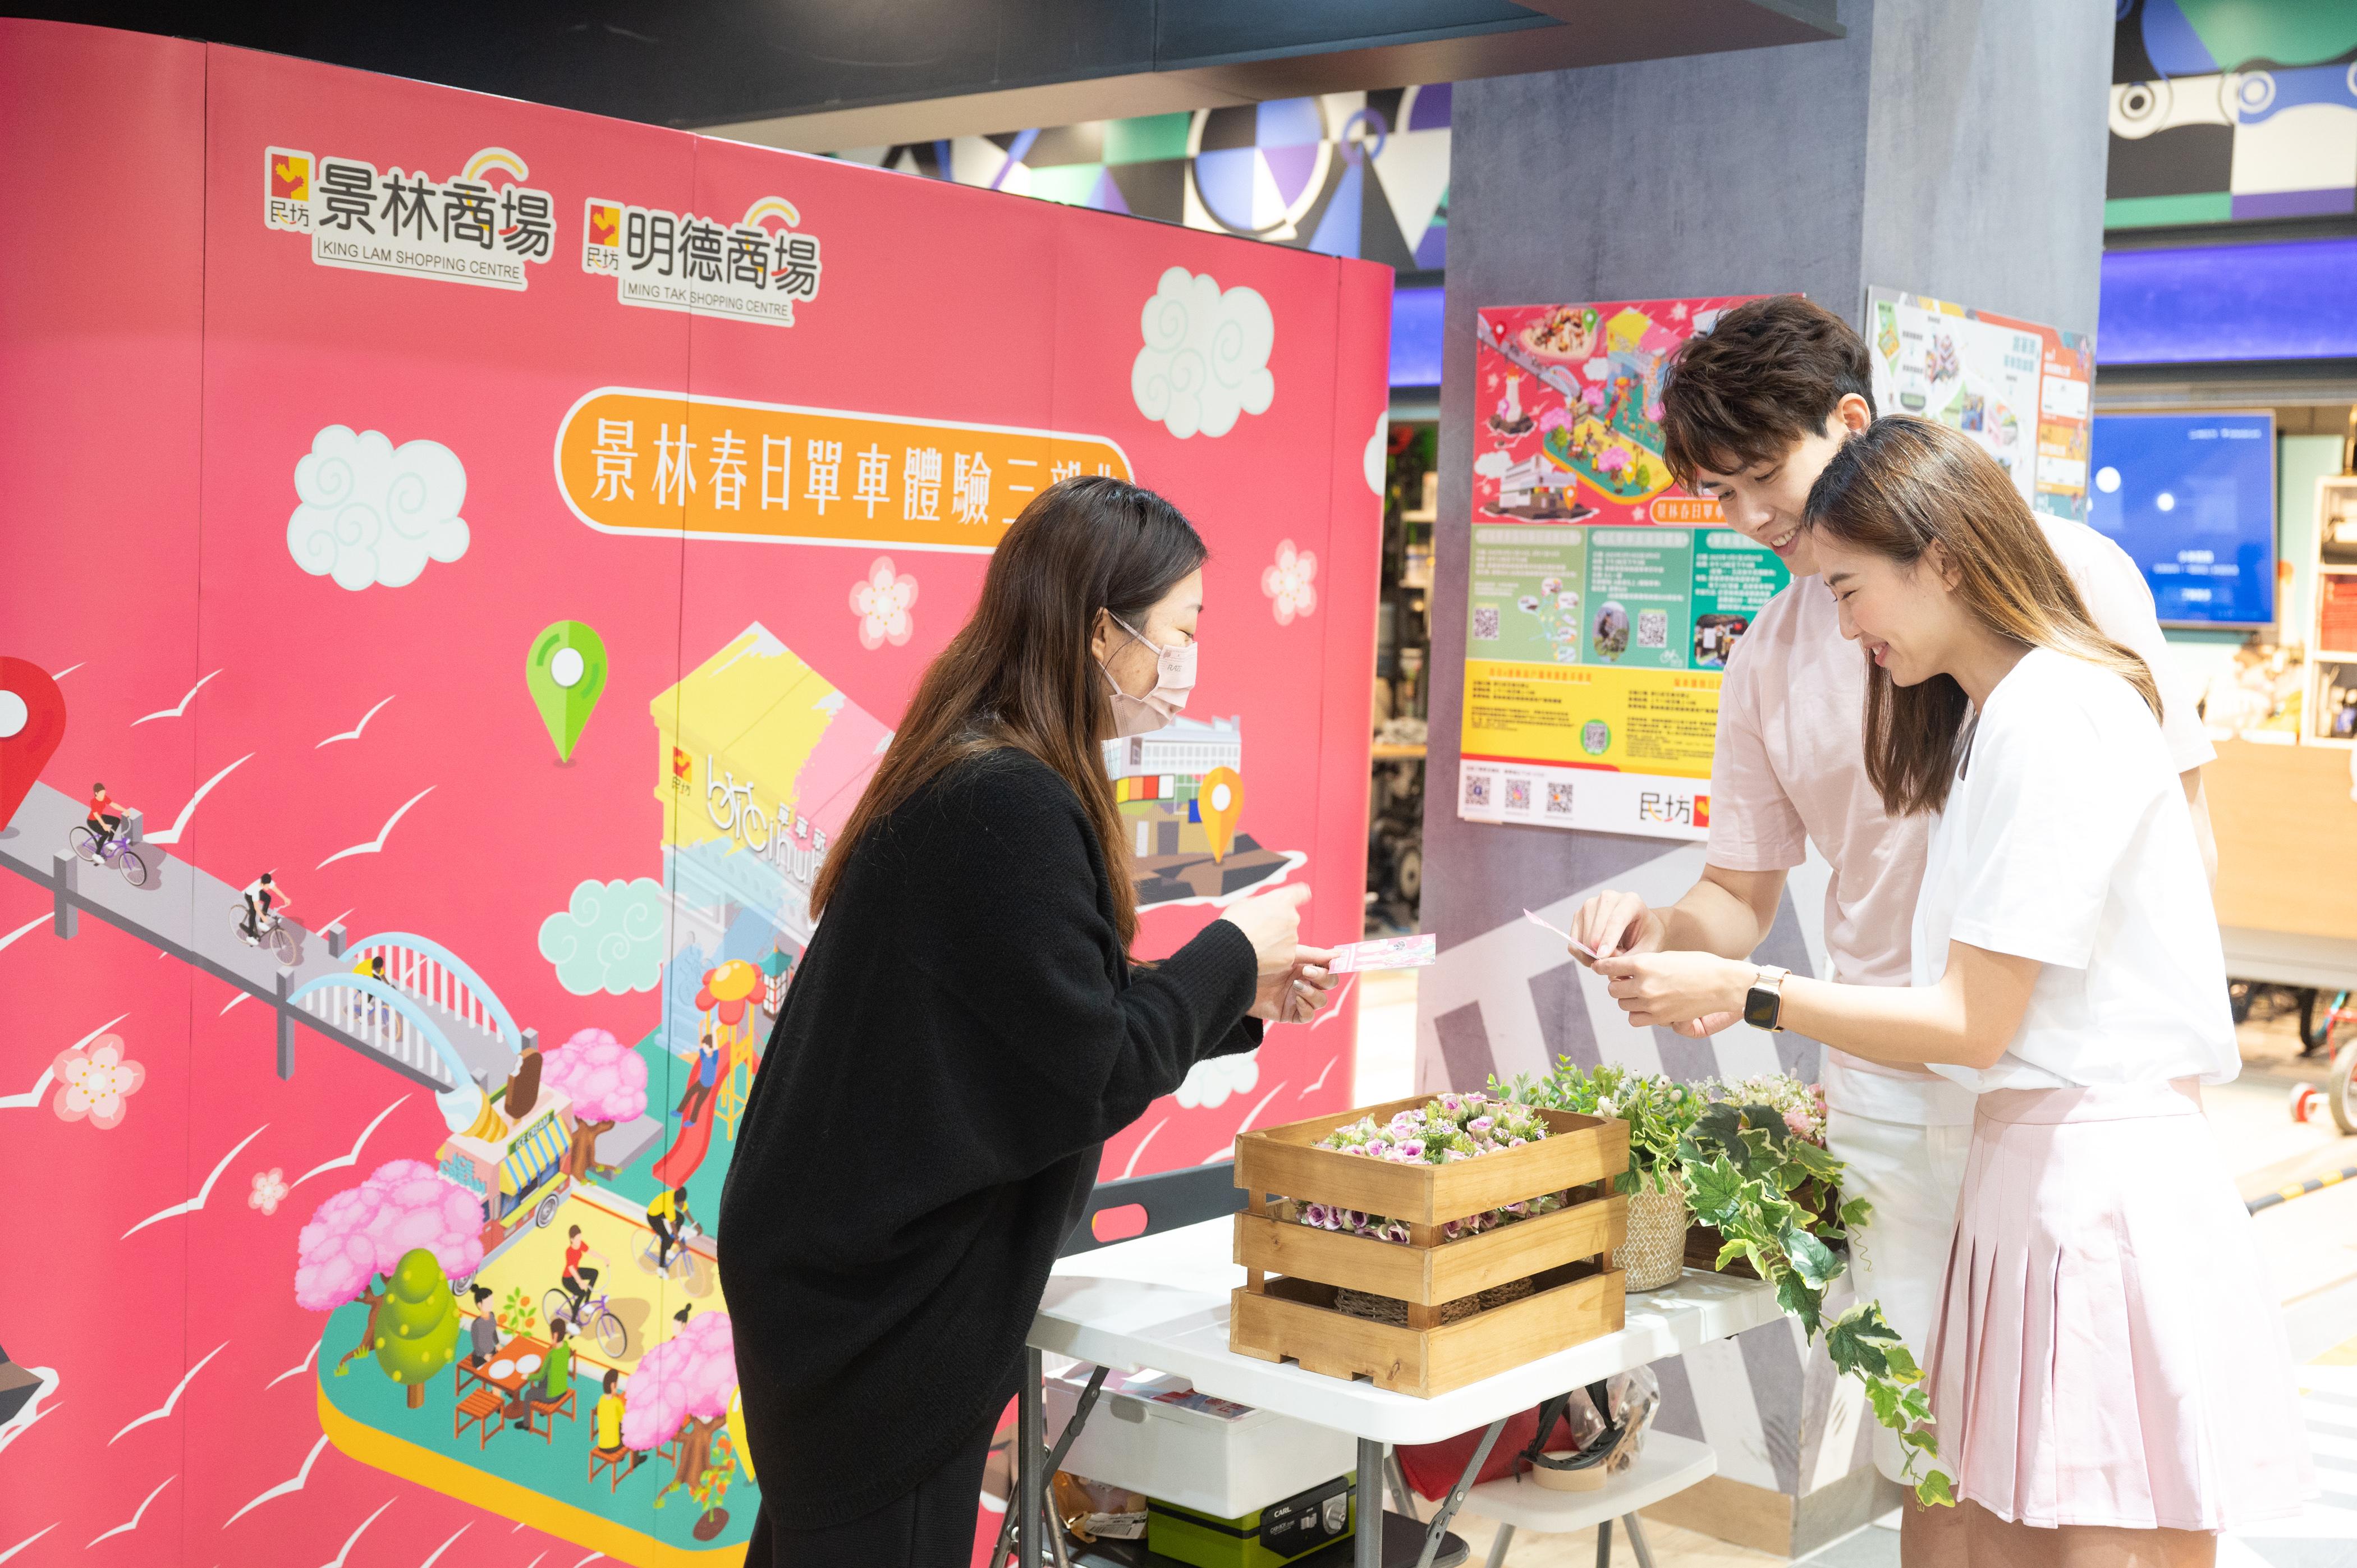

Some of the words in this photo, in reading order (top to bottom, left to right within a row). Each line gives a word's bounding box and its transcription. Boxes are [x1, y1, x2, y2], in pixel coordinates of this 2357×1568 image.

[270, 200, 309, 227] 民坊
[319, 163, 551, 256] 景林商場
[324, 240, 358, 256] KING
[363, 246, 391, 262] LAM
[396, 250, 466, 272] SHOPPING
[470, 260, 520, 279] CENTRE
[587, 246, 618, 270] 民坊
[627, 212, 817, 295] 明德商場
[628, 282, 661, 297] MING
[664, 287, 686, 301] TAK
[690, 291, 744, 310] SHOPPING
[746, 300, 788, 317] CENTRE
[591, 418, 1117, 525] 景林春日單車體驗三
[1640, 792, 1690, 824] 民坊
[1274, 1506, 1292, 1518] CARL
